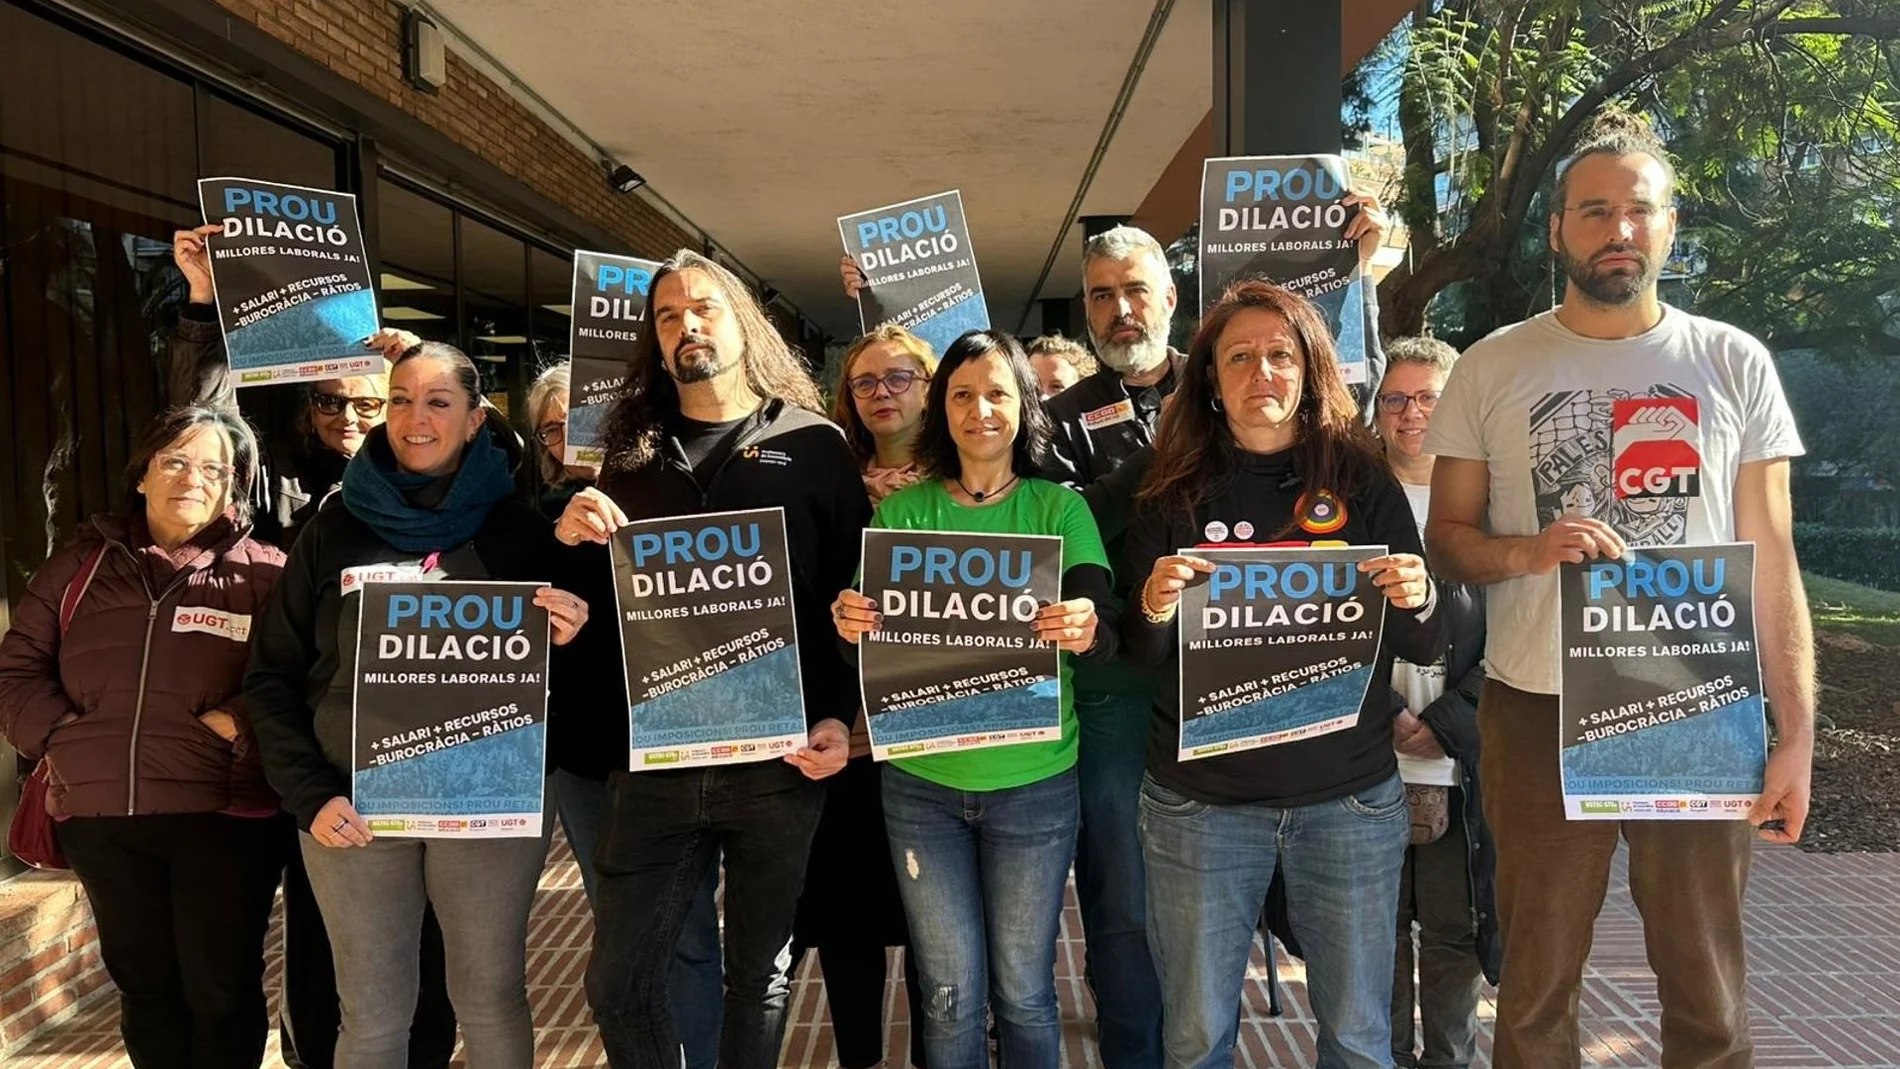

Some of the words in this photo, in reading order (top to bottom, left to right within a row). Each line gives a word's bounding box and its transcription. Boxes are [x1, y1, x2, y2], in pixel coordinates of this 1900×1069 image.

[1226, 167, 1342, 202] PROU
[224, 188, 336, 224] PROU
[1219, 199, 1347, 232] DILACIÓ
[223, 217, 347, 246] DILACIÓ
[857, 205, 947, 249] PROU
[215, 246, 276, 259] MILLORES
[279, 246, 341, 261] LABORALS
[344, 254, 360, 263] JA!
[861, 229, 958, 271] DILACIÓ
[1207, 242, 1267, 254] MILLORES
[1271, 240, 1333, 252] LABORALS
[1336, 239, 1354, 250] JA!
[598, 264, 650, 297] PR
[864, 272, 905, 287] ILLORES
[907, 261, 955, 279] LABORALS
[956, 258, 970, 268] JA!
[1280, 267, 1336, 291] ECURSOS
[240, 291, 279, 312] SALARI
[287, 273, 348, 293] RECURSOS
[321, 282, 362, 297] RÀTIOS
[918, 282, 962, 312] RECURSOS
[1305, 276, 1350, 299] RÀTIOS
[903, 309, 938, 331] CRÀCIA
[942, 288, 974, 311] RÀTIOS
[578, 327, 638, 342] MILLORES
[591, 376, 625, 392] SALA
[1538, 430, 1609, 482] PALES
[1619, 467, 1697, 495] CGT
[632, 523, 761, 569] PROU
[631, 555, 773, 598] DILACIÓ
[890, 545, 1032, 588] PROU
[1590, 557, 1726, 601] PROU
[1209, 562, 1357, 601] PROU
[387, 594, 523, 630] PROU
[626, 607, 689, 621] MILLORES
[693, 599, 762, 616] LABORALS
[767, 596, 786, 607] JA!
[882, 588, 1040, 623] DILACIÓ
[1202, 596, 1365, 630] DILACIÓ
[1582, 593, 1736, 633] DILACIÓ
[193, 613, 247, 635] UGT.cat
[378, 629, 531, 661] DILACIÓ
[738, 637, 786, 664] RÀTIOS
[868, 630, 941, 646] MILLORES
[946, 634, 1024, 649] LABORALS
[1028, 638, 1050, 650] JA!
[1189, 636, 1263, 651] MILLORES
[1268, 632, 1346, 646] LABORALS
[1350, 630, 1373, 640] JA!
[1569, 646, 1647, 658] MILLORES
[1652, 641, 1726, 657] LABORALS
[1730, 640, 1750, 652] JA!
[650, 659, 693, 683] SALARI
[702, 627, 770, 662] RECURSOS
[364, 672, 437, 684] MILLORES
[441, 672, 516, 684] LABORALS
[519, 672, 540, 684] JA!
[890, 684, 940, 703] SALARI
[952, 667, 1029, 689] RECURSOS
[992, 674, 1046, 692] RÀTIOS
[1208, 680, 1258, 702] SALARI
[1271, 656, 1348, 684] RECURSOS
[1310, 661, 1363, 684] RÀTIOS
[1590, 702, 1643, 725] SALARI
[1657, 675, 1734, 707] RECURSOS
[1699, 686, 1750, 713] RÀTIOS
[381, 726, 431, 749] SALARI
[444, 703, 518, 733] RECURSOS
[483, 714, 533, 737] RÀTIOS
[735, 723, 766, 735] PROU
[769, 720, 800, 733] RETA
[768, 741, 785, 749] UGT
[1588, 778, 1682, 790] IMPOSICIONS!
[1685, 778, 1722, 789] PROU
[468, 800, 500, 810] PROU
[1690, 800, 1708, 808] CGT
